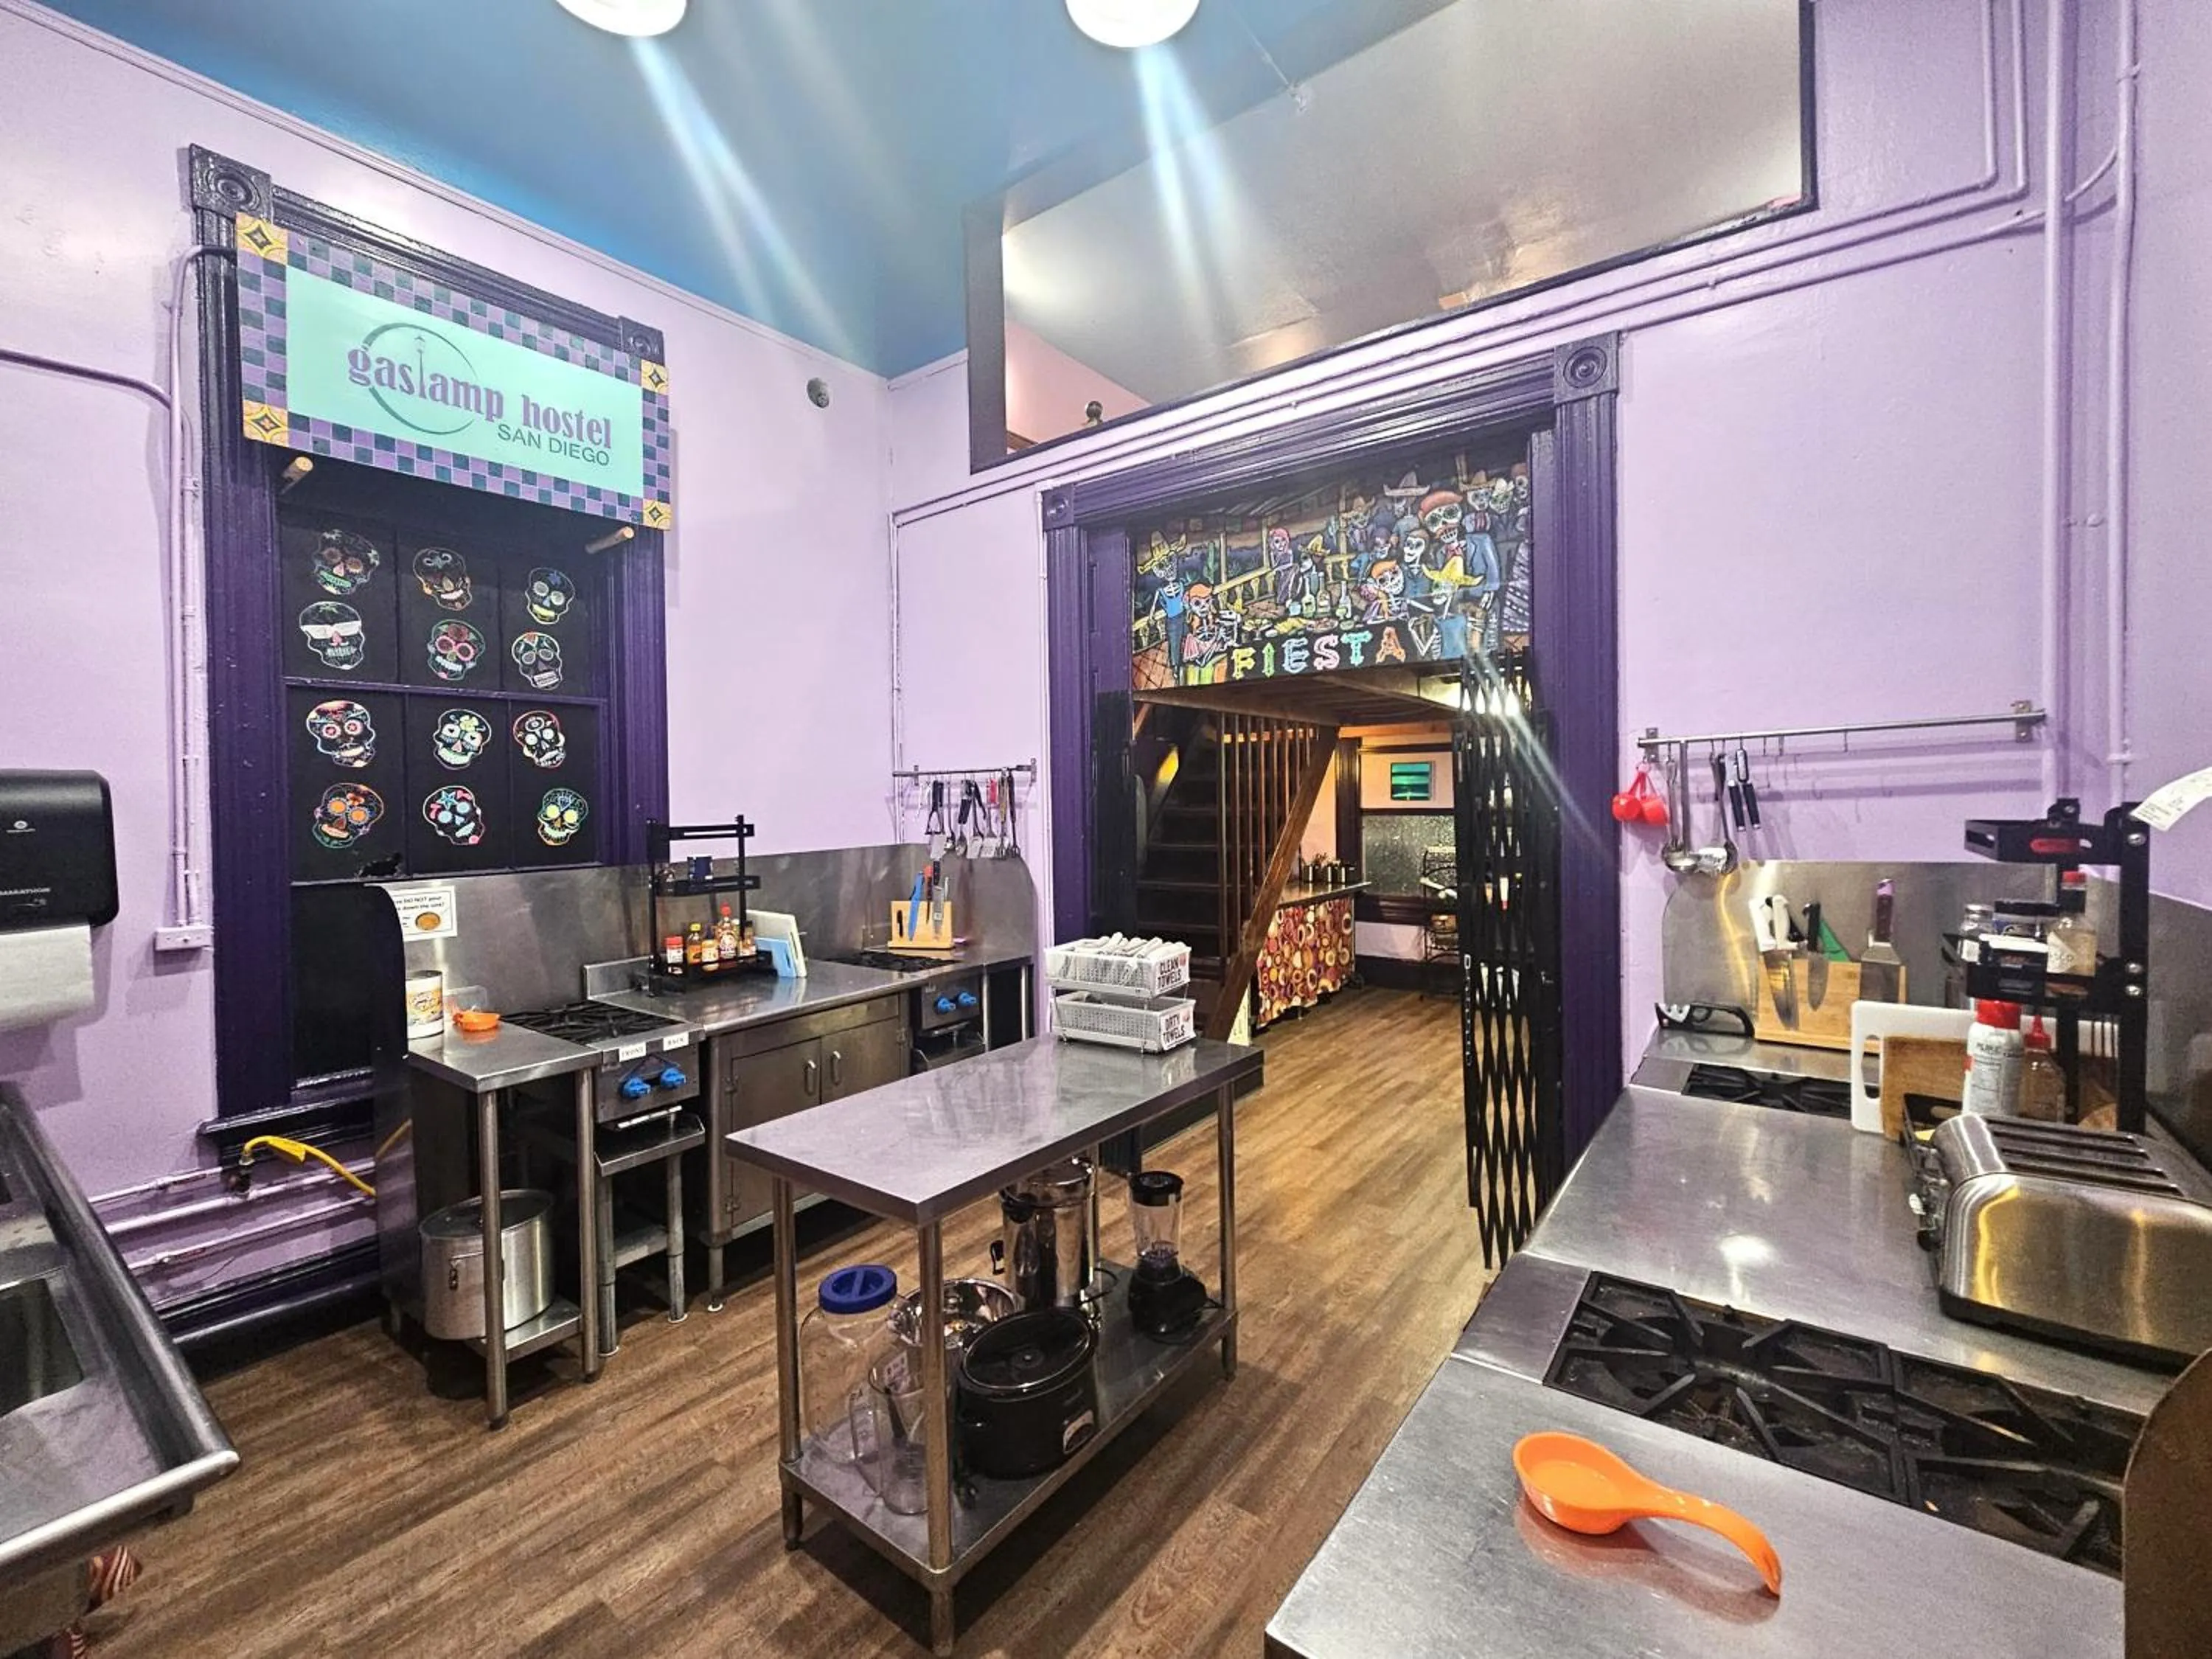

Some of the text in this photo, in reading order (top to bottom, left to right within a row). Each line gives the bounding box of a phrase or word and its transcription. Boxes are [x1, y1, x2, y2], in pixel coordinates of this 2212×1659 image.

[347, 335, 611, 449] gaslamp hostel
[498, 424, 611, 467] SAN DIEGO
[1232, 626, 1405, 680] FIESTA
[1160, 957, 1179, 975] CLEAN
[1158, 970, 1181, 988] TOWELS
[1165, 1014, 1180, 1031] DIRTY
[1163, 1025, 1185, 1043] TOWELS
